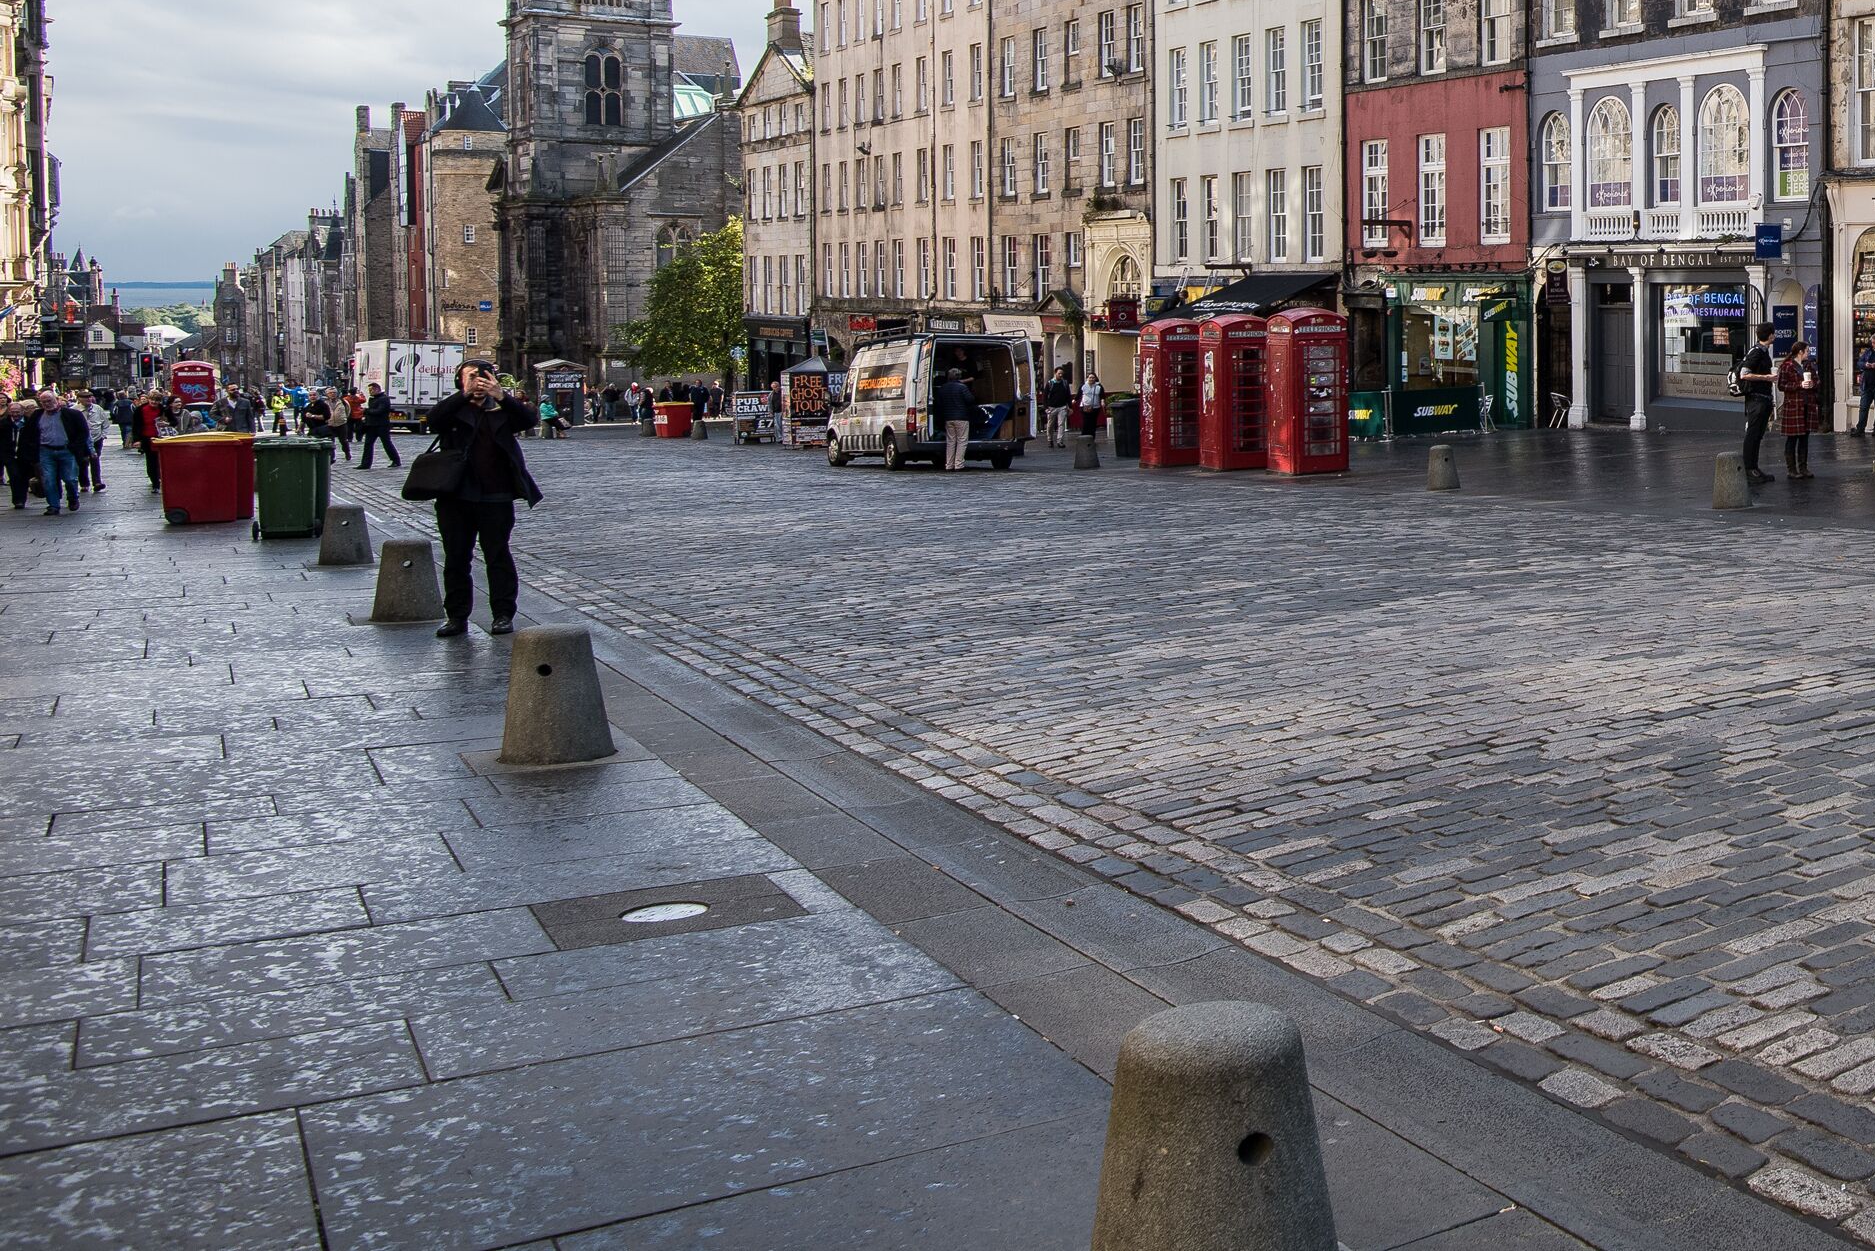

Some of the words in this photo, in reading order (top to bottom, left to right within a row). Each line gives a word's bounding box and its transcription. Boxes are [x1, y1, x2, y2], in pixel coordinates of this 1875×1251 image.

[1613, 255, 1633, 266] BAY
[1641, 255, 1654, 266] OF
[1663, 254, 1711, 265] BENGAL
[1738, 255, 1754, 263] 1978
[1411, 287, 1445, 300] SUBWAY
[1463, 288, 1502, 301] SUB
[1689, 294, 1700, 305] OF
[1704, 293, 1745, 305] BENGAL
[1484, 300, 1509, 320] SUBWAY
[1695, 308, 1745, 316] RESTAURANT
[930, 319, 959, 329] WARHAMMER
[1300, 325, 1341, 333] TELEPHONE
[1505, 320, 1518, 418] SUBWAY
[793, 375, 822, 388] FREE
[829, 373, 846, 384] FR
[791, 388, 828, 400] GHOST
[737, 405, 770, 413] CRAW
[792, 400, 826, 413] TOUR
[1413, 404, 1458, 417] SUBWAY
[758, 419, 773, 428] £7
